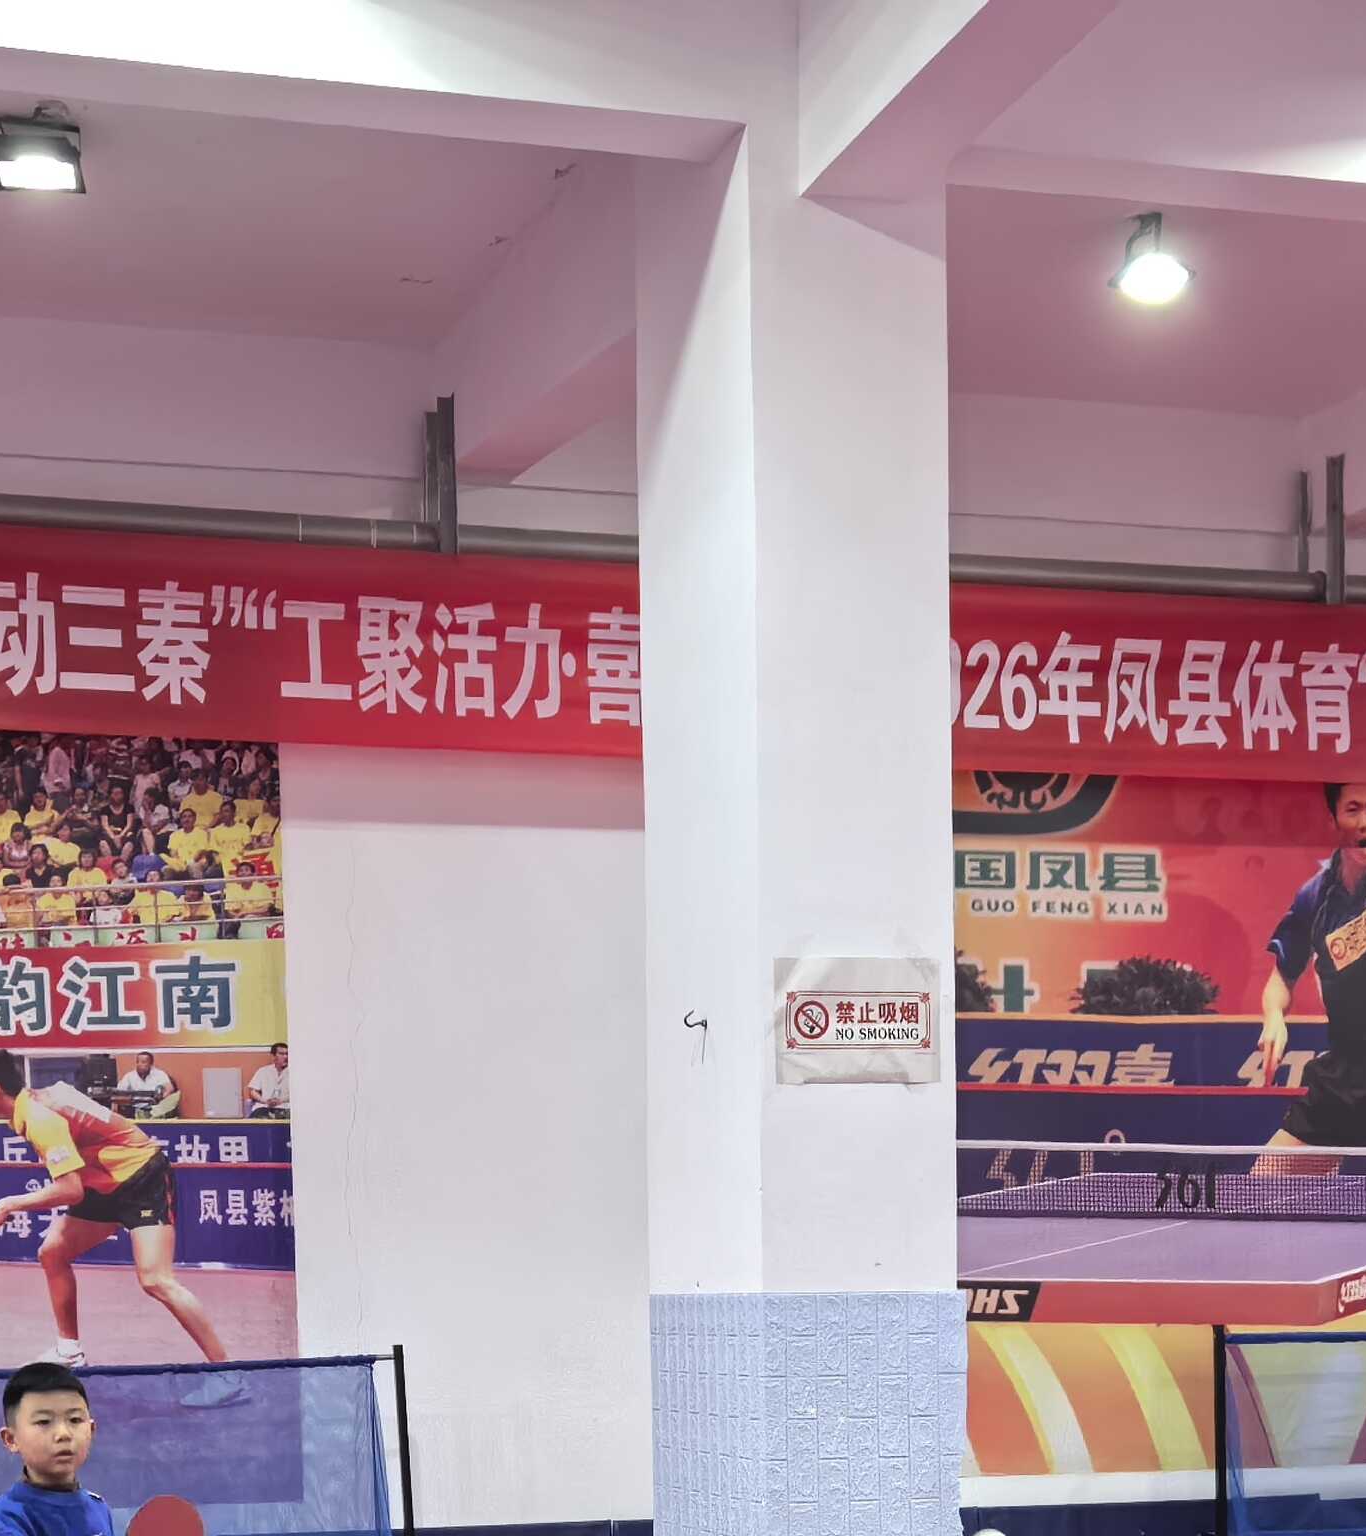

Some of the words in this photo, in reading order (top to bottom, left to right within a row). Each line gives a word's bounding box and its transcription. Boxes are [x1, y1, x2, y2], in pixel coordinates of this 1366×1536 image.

[955, 849, 1162, 894] 国凤县
[970, 899, 1015, 914] GUO
[1032, 900, 1091, 915] FENG
[1107, 901, 1164, 916] XIAN
[835, 1001, 920, 1025] 禁止吸烟
[835, 1027, 855, 1041] NO
[858, 1027, 920, 1041] SMOKING
